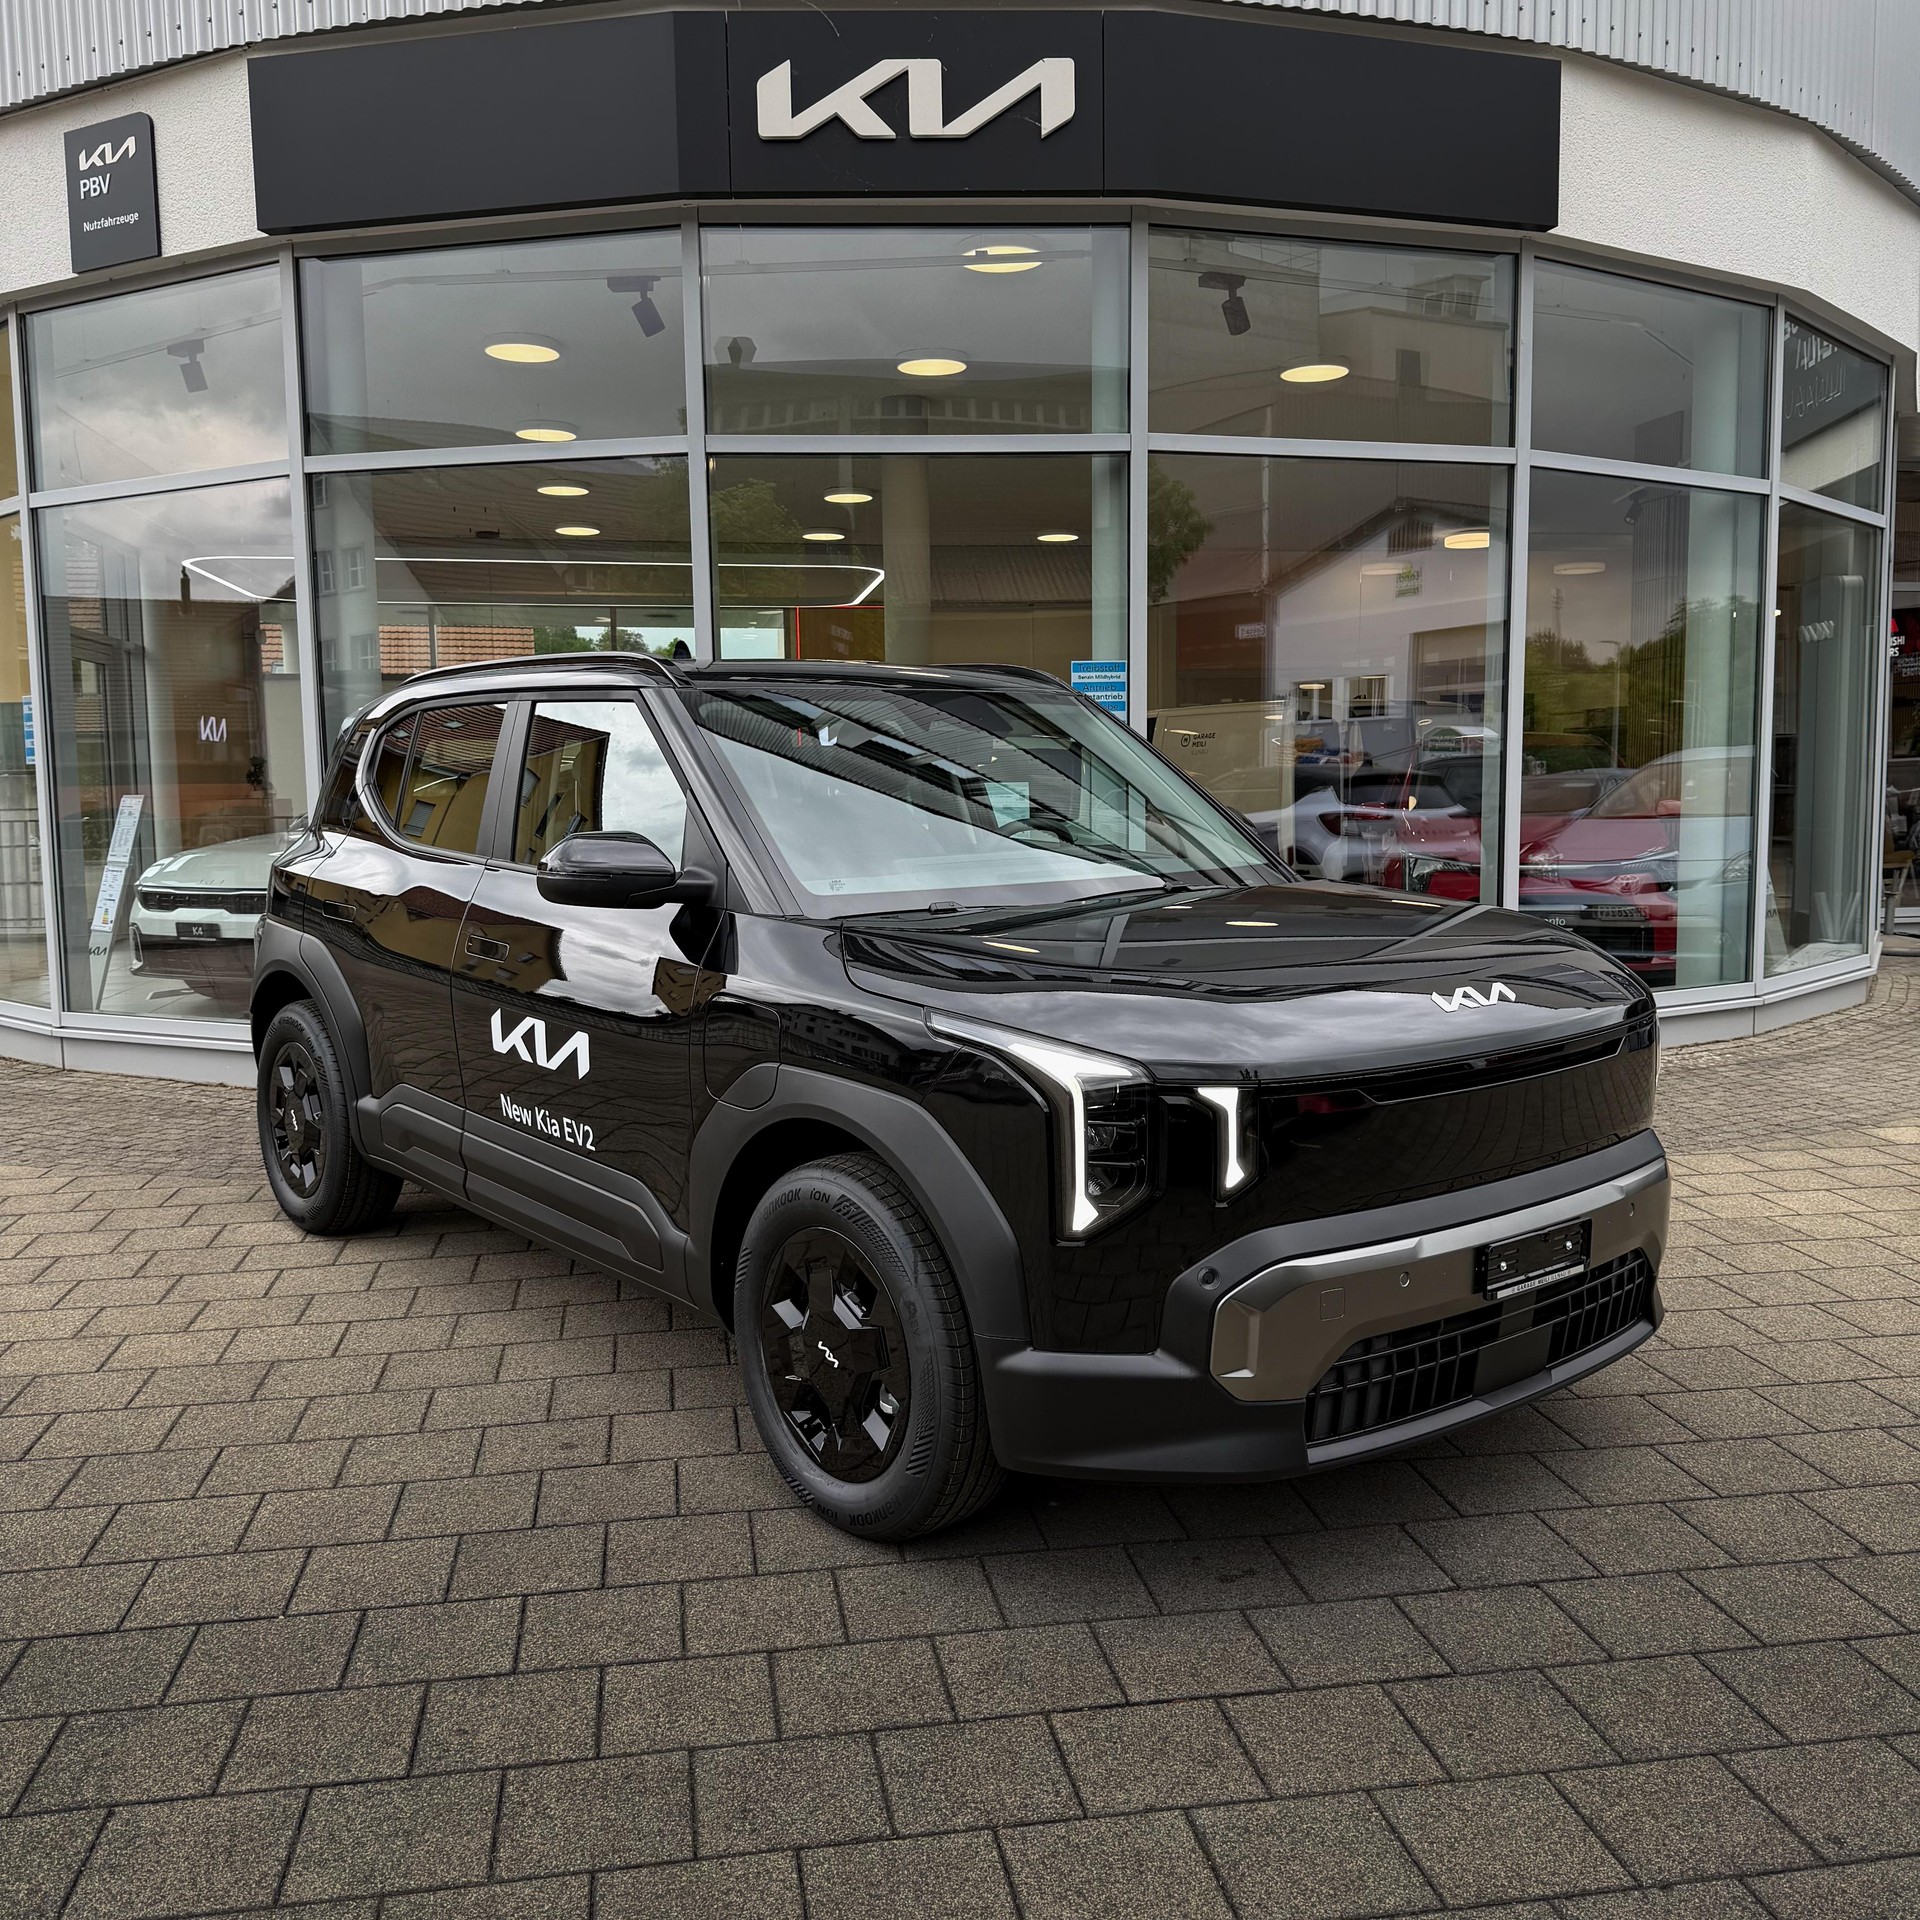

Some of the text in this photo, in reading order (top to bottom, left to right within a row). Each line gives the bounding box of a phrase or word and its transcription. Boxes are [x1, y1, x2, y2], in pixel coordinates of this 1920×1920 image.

[757, 58, 1075, 140] KIA
[79, 136, 136, 171] KIA
[80, 173, 111, 199] PBV
[83, 212, 139, 232] Nutzfahrzeuge
[1078, 663, 1120, 672] Treibstoff
[1082, 683, 1117, 691] Antrieb
[1192, 732, 1216, 740] GARAGE
[192, 926, 204, 936] K4
[1430, 982, 1516, 1013] KIA
[490, 1007, 591, 1080] KIA
[500, 1093, 596, 1152] New Kia EV2
[1516, 1280, 1536, 1291] GARAGE
